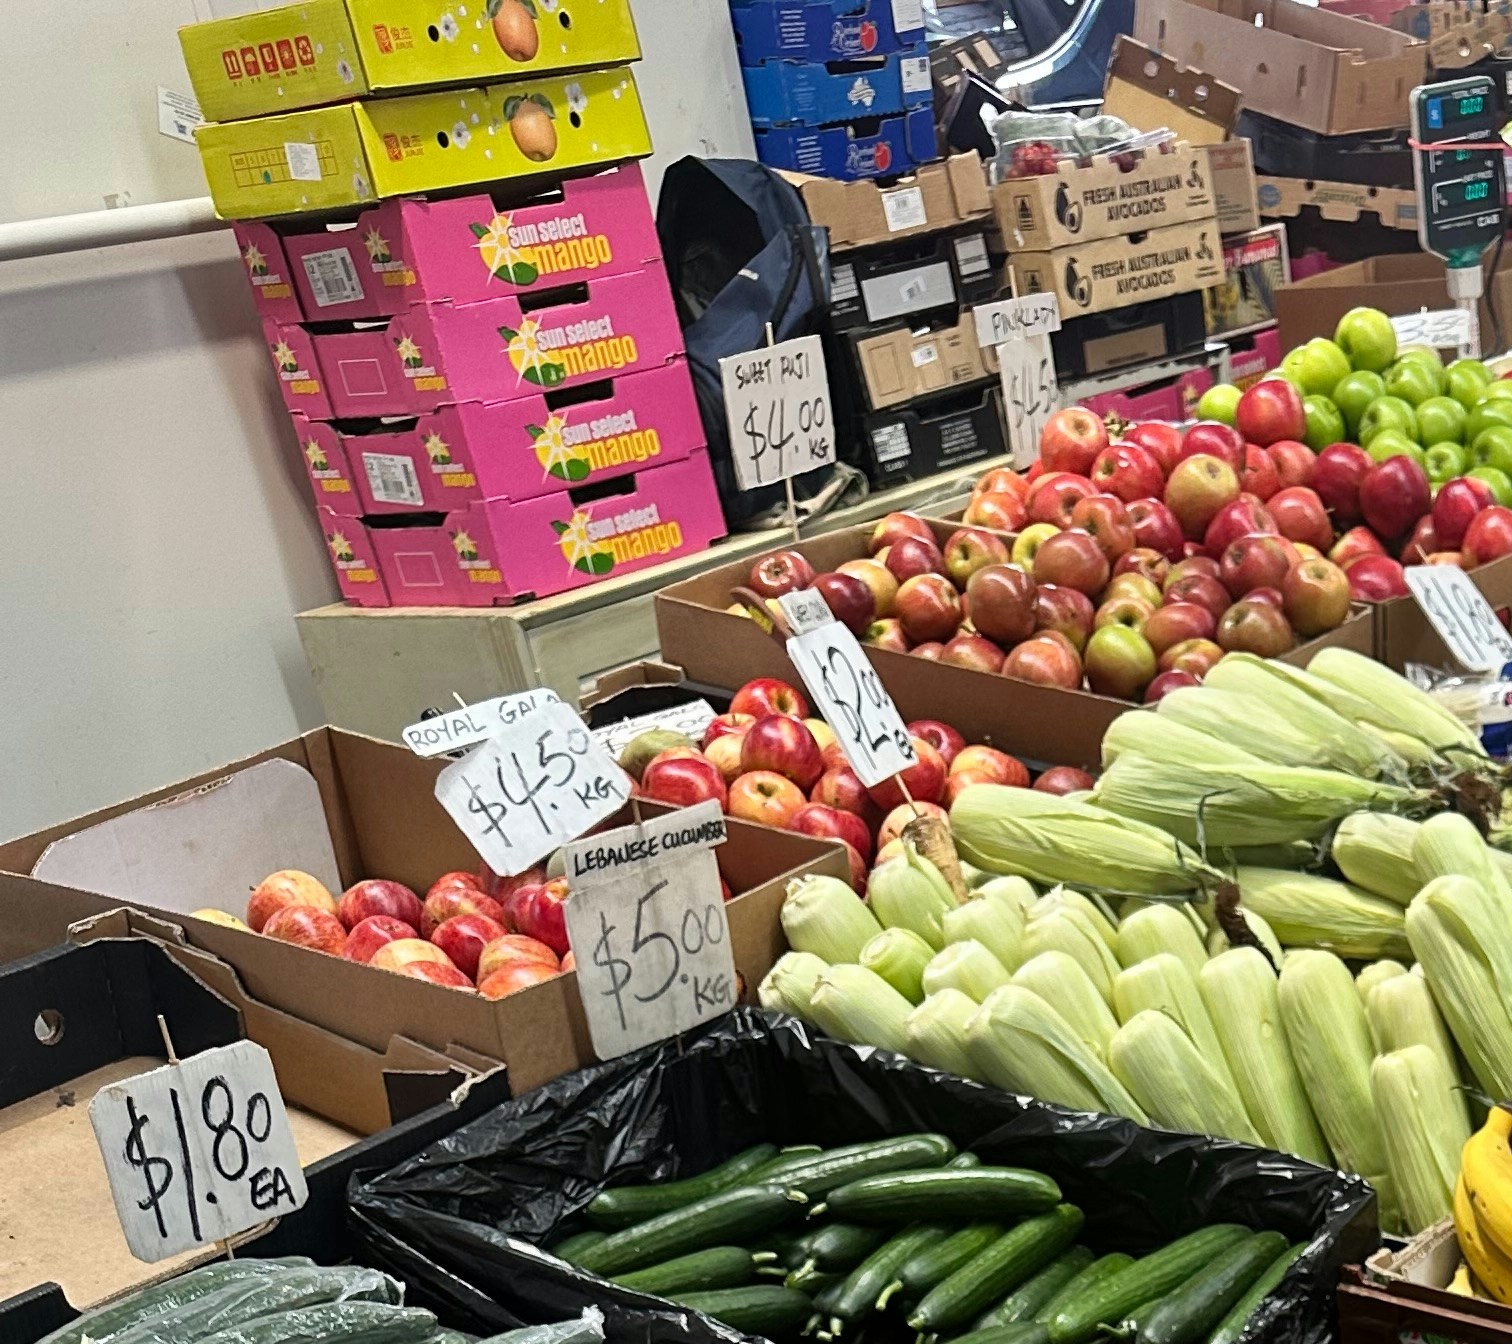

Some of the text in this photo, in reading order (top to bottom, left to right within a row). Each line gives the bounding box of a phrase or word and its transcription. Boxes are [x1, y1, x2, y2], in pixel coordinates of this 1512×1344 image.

[1082, 173, 1182, 207] FRESH AUSTRALIAN
[1106, 197, 1167, 221] AVOCADOS
[508, 213, 588, 249] sun select
[534, 234, 613, 276] mango
[1091, 247, 1192, 281] FRESH AUSTRALIAN
[1116, 269, 1176, 295] AVOCADOS
[536, 315, 615, 351] sun select
[563, 335, 639, 377] mango
[587, 428, 662, 472] mango
[743, 397, 826, 484] $4.00
[808, 437, 831, 463] KG
[613, 520, 684, 565] mango
[407, 713, 487, 750] ROYAL
[462, 728, 590, 848] $4.50
[573, 776, 626, 810] KG
[574, 836, 660, 878] LEBANESE
[593, 880, 724, 1031] $5.00
[693, 973, 733, 1015] KG
[124, 1075, 273, 1241] $1.80
[249, 1166, 297, 1210] EA
